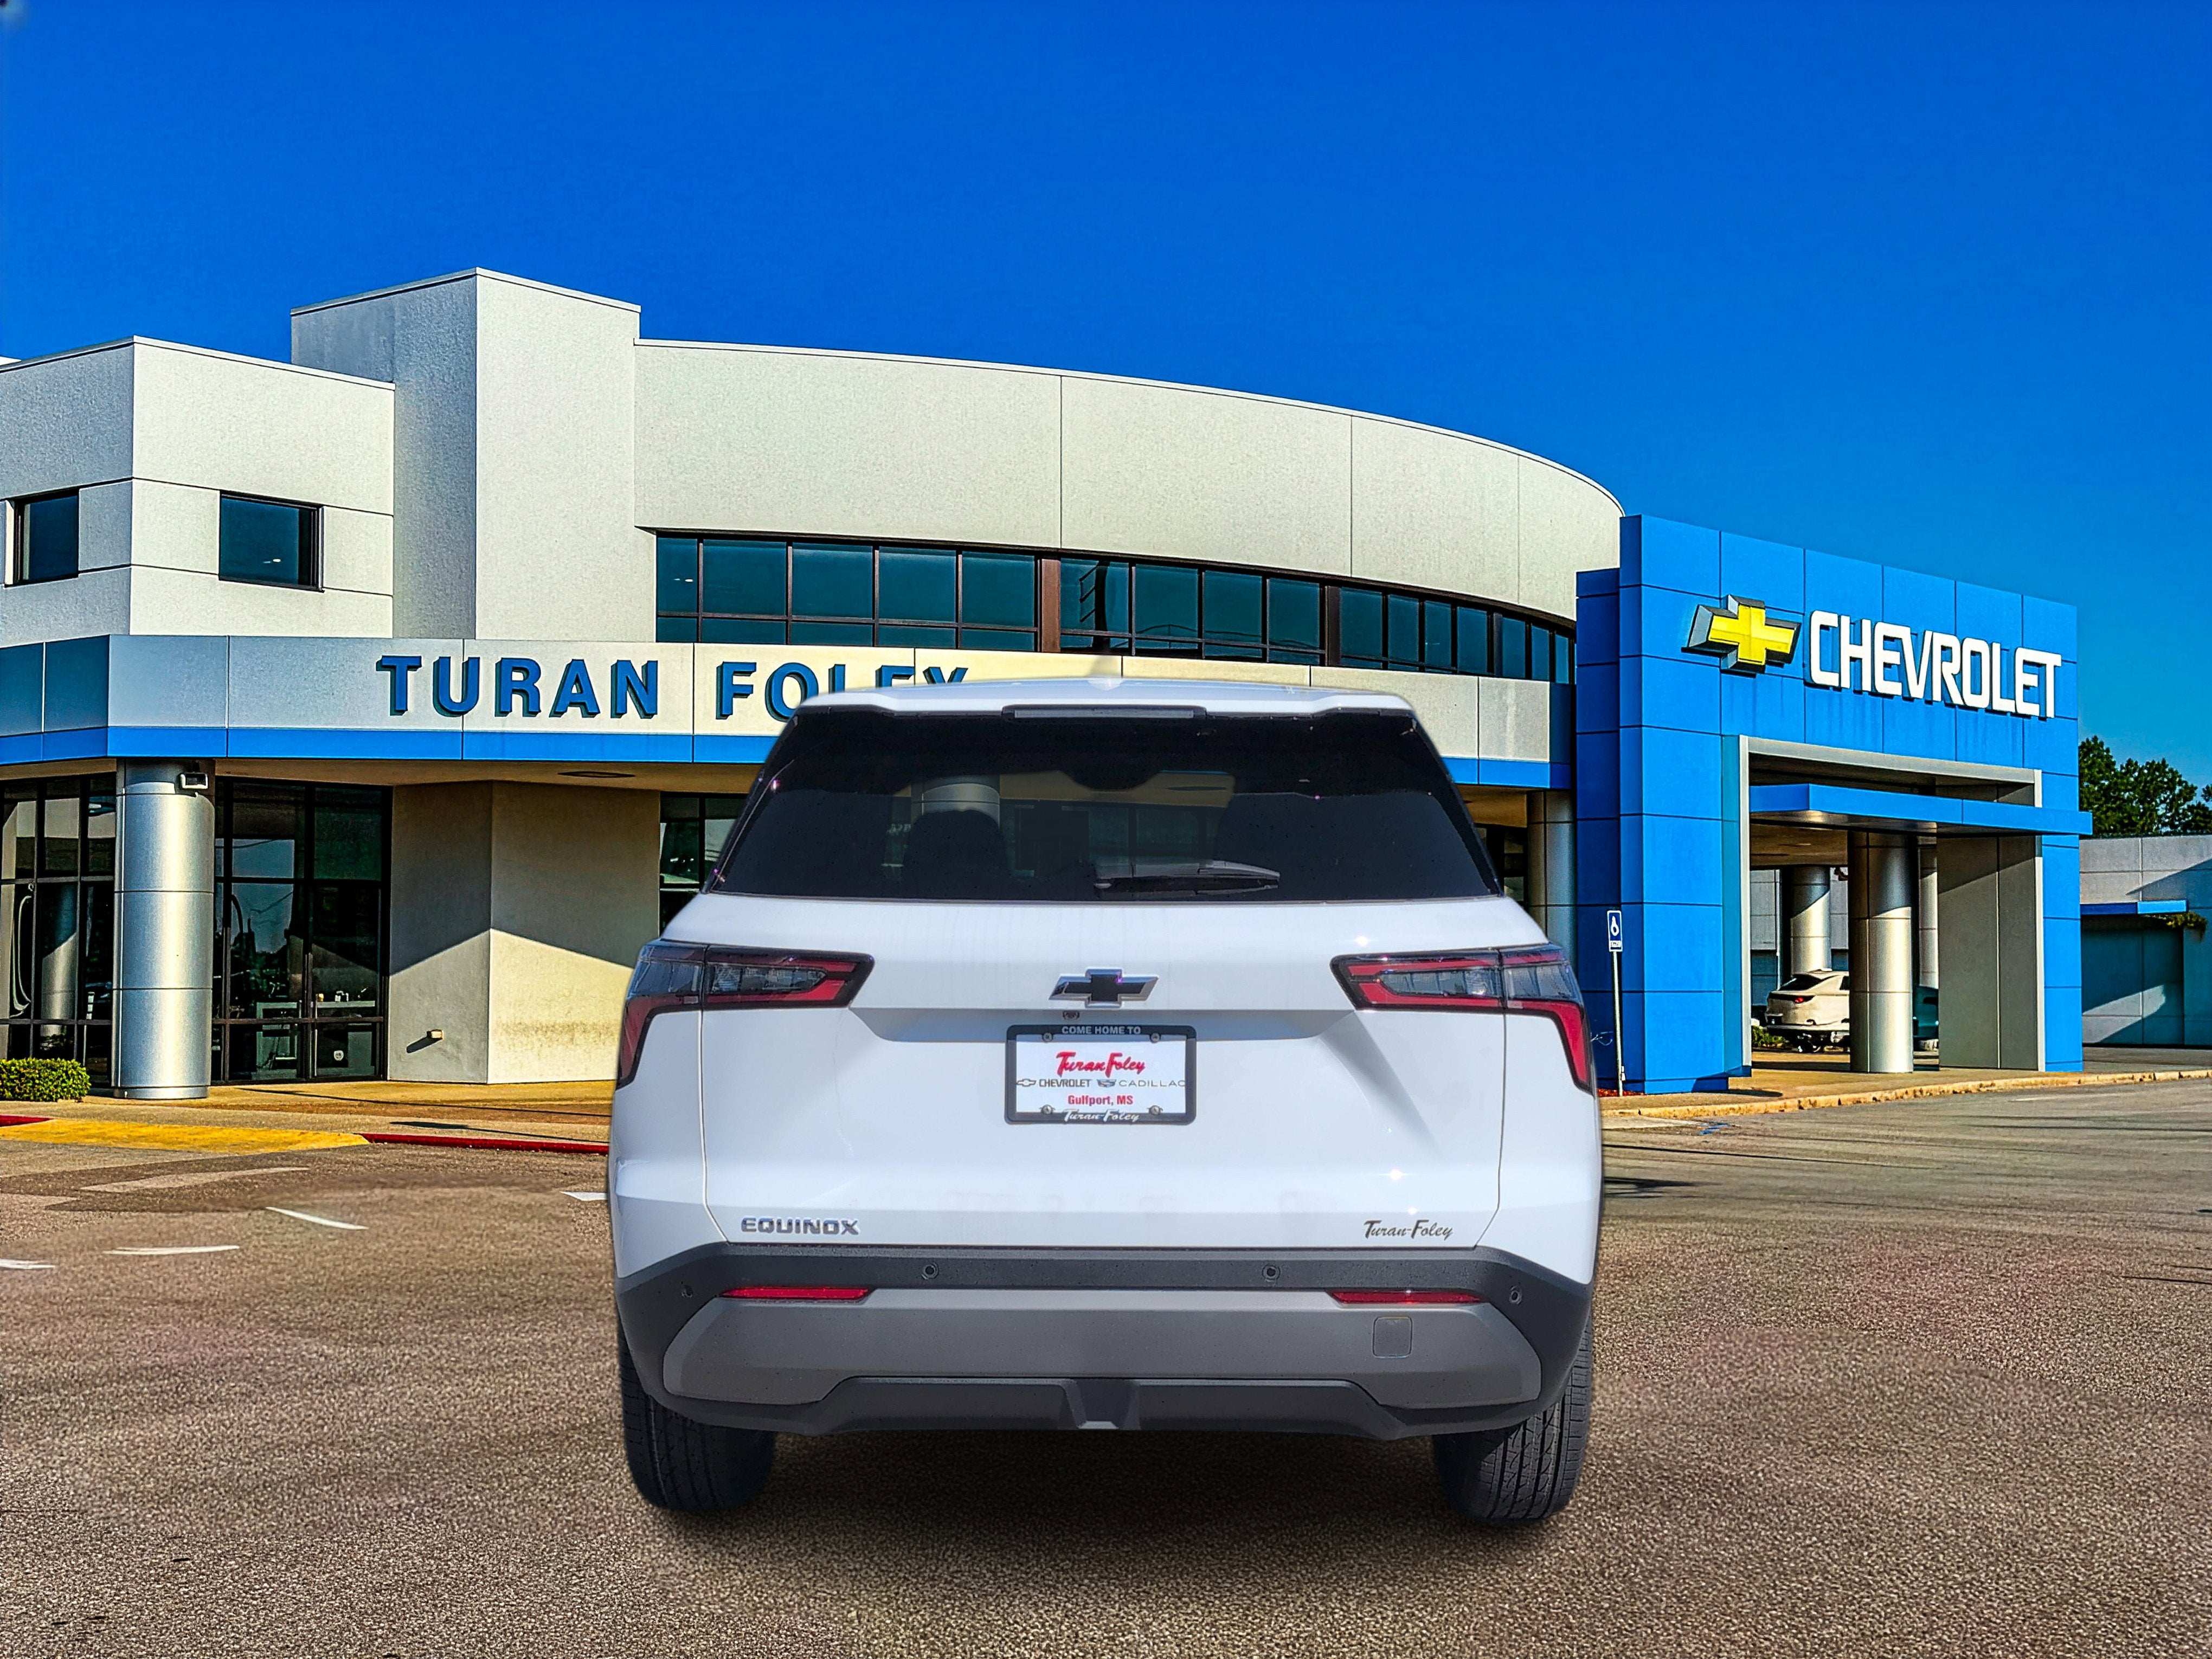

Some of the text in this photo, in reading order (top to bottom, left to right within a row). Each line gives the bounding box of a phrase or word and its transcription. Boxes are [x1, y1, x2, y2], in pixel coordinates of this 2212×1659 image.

[1809, 610, 2061, 718] CHEVROLET
[376, 655, 658, 718] TURAN
[1062, 1026, 1141, 1034] COME HOME TO
[1039, 1078, 1091, 1088] CHEVROLET
[1068, 1095, 1133, 1107] Gulfport, MS
[741, 1217, 859, 1235] EQUINOX
